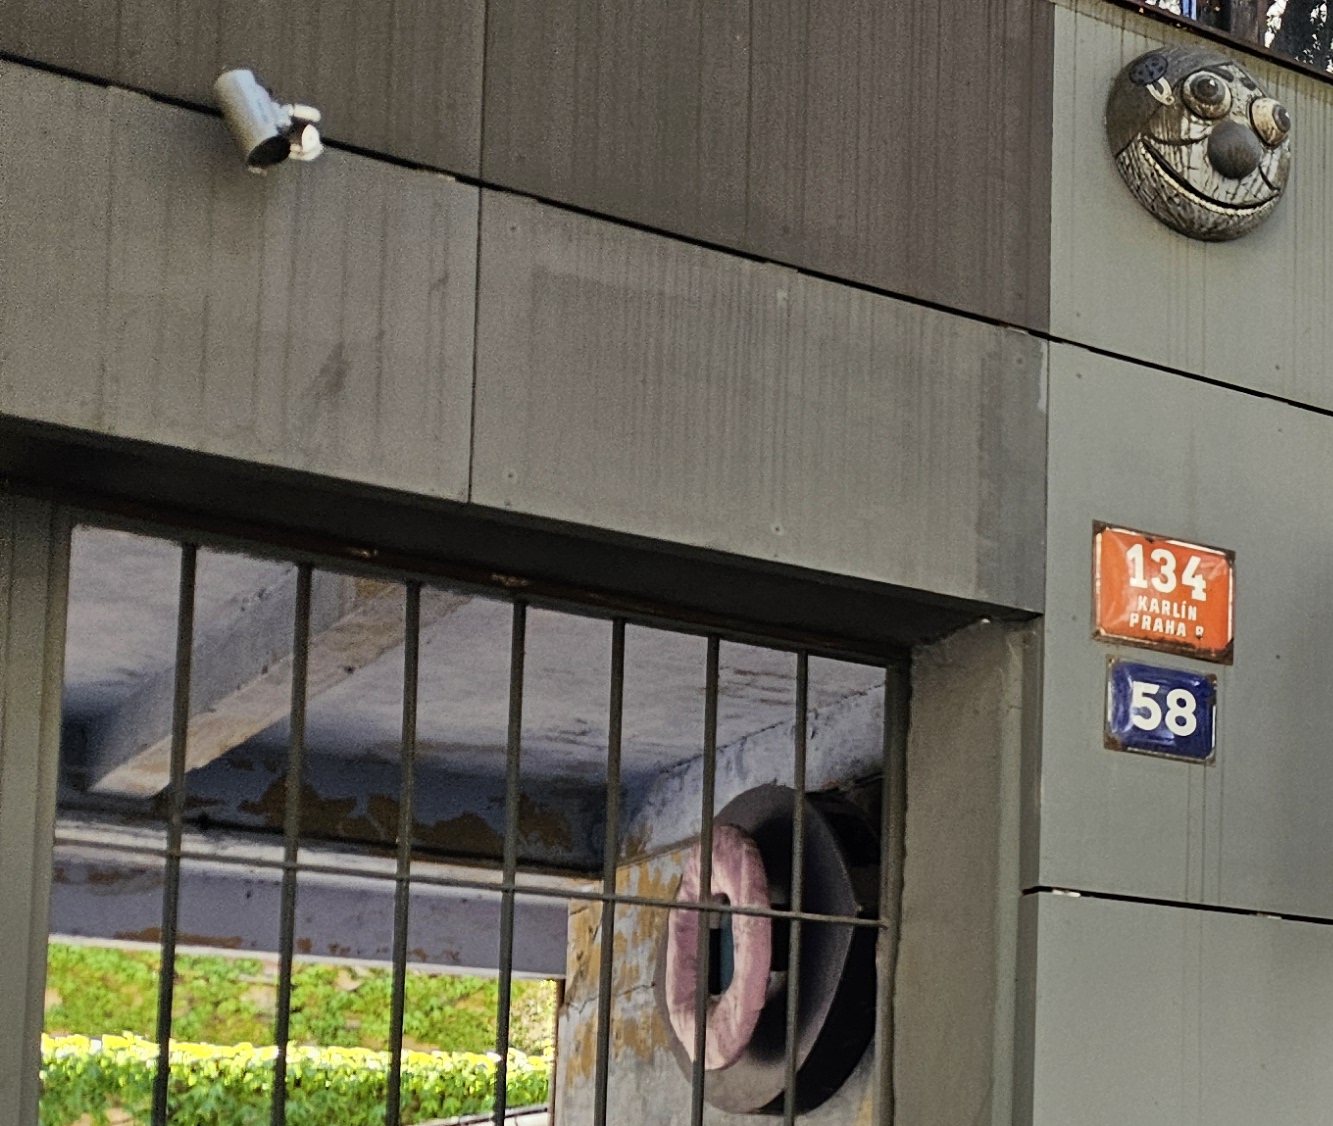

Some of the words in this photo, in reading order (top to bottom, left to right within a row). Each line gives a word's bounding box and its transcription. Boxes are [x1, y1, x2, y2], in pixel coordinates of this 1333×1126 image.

[1126, 543, 1207, 602] 134
[1129, 613, 1187, 637] PRAHA
[1137, 595, 1197, 621] KARLÍN
[1132, 680, 1197, 737] 58
